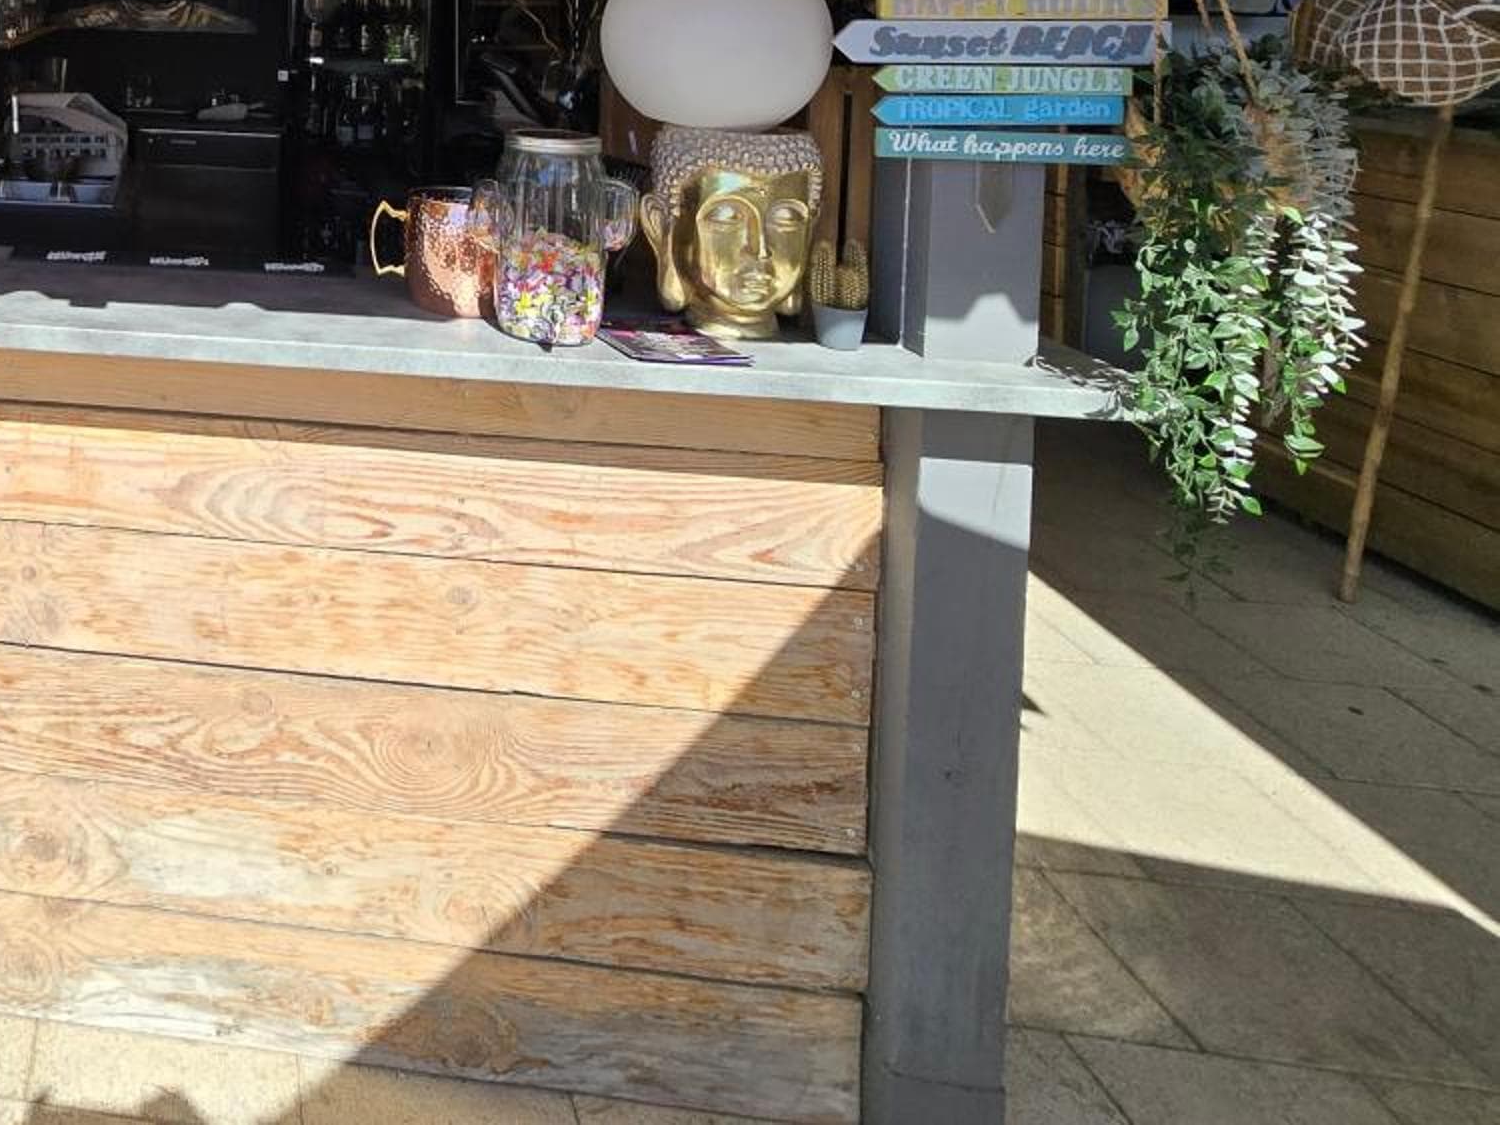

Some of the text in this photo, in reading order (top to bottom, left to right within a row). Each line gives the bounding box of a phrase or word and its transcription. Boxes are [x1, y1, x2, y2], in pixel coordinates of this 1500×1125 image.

[869, 26, 1008, 58] Sunset
[897, 66, 1126, 94] GREEN JUNGLE
[900, 97, 1112, 121] TROPICAL garden
[888, 130, 1125, 161] What happens here
